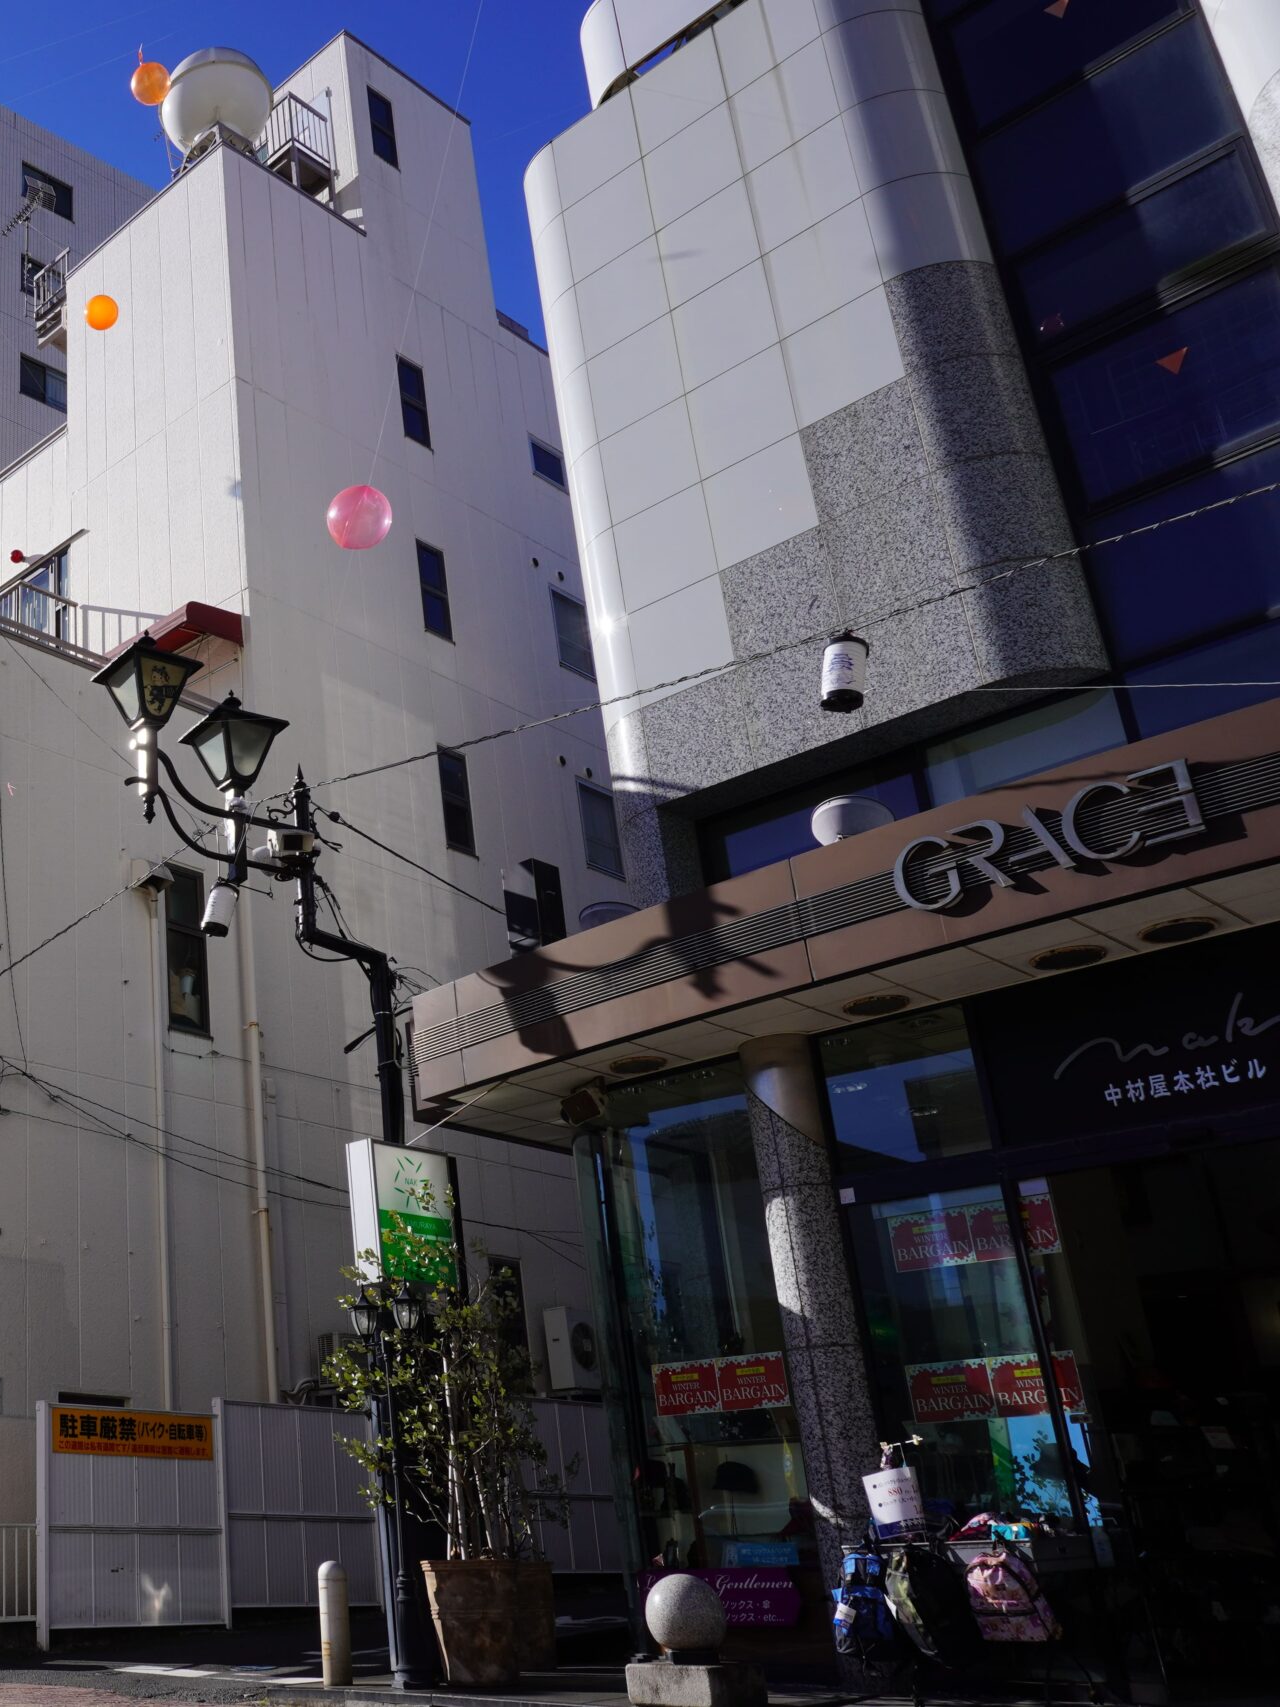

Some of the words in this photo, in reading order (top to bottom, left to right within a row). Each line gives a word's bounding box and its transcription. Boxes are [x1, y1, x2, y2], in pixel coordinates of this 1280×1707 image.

[1103, 1058, 1267, 1108] 中村屋本社ビル
[913, 1232, 950, 1244] WINTER
[976, 1227, 1056, 1252] BARAIN
[896, 1239, 971, 1262] BARGAIN
[672, 1381, 701, 1392] WINTER
[736, 1375, 768, 1385] WINTER
[932, 1384, 968, 1395] WINTER
[1016, 1378, 1045, 1389] WINT
[658, 1390, 718, 1408] BARGAIN
[722, 1383, 786, 1402] BARGAIN
[996, 1386, 1080, 1406] BARGIN
[915, 1393, 991, 1413] BARGAIN
[715, 1573, 793, 1598] Gentlemen
